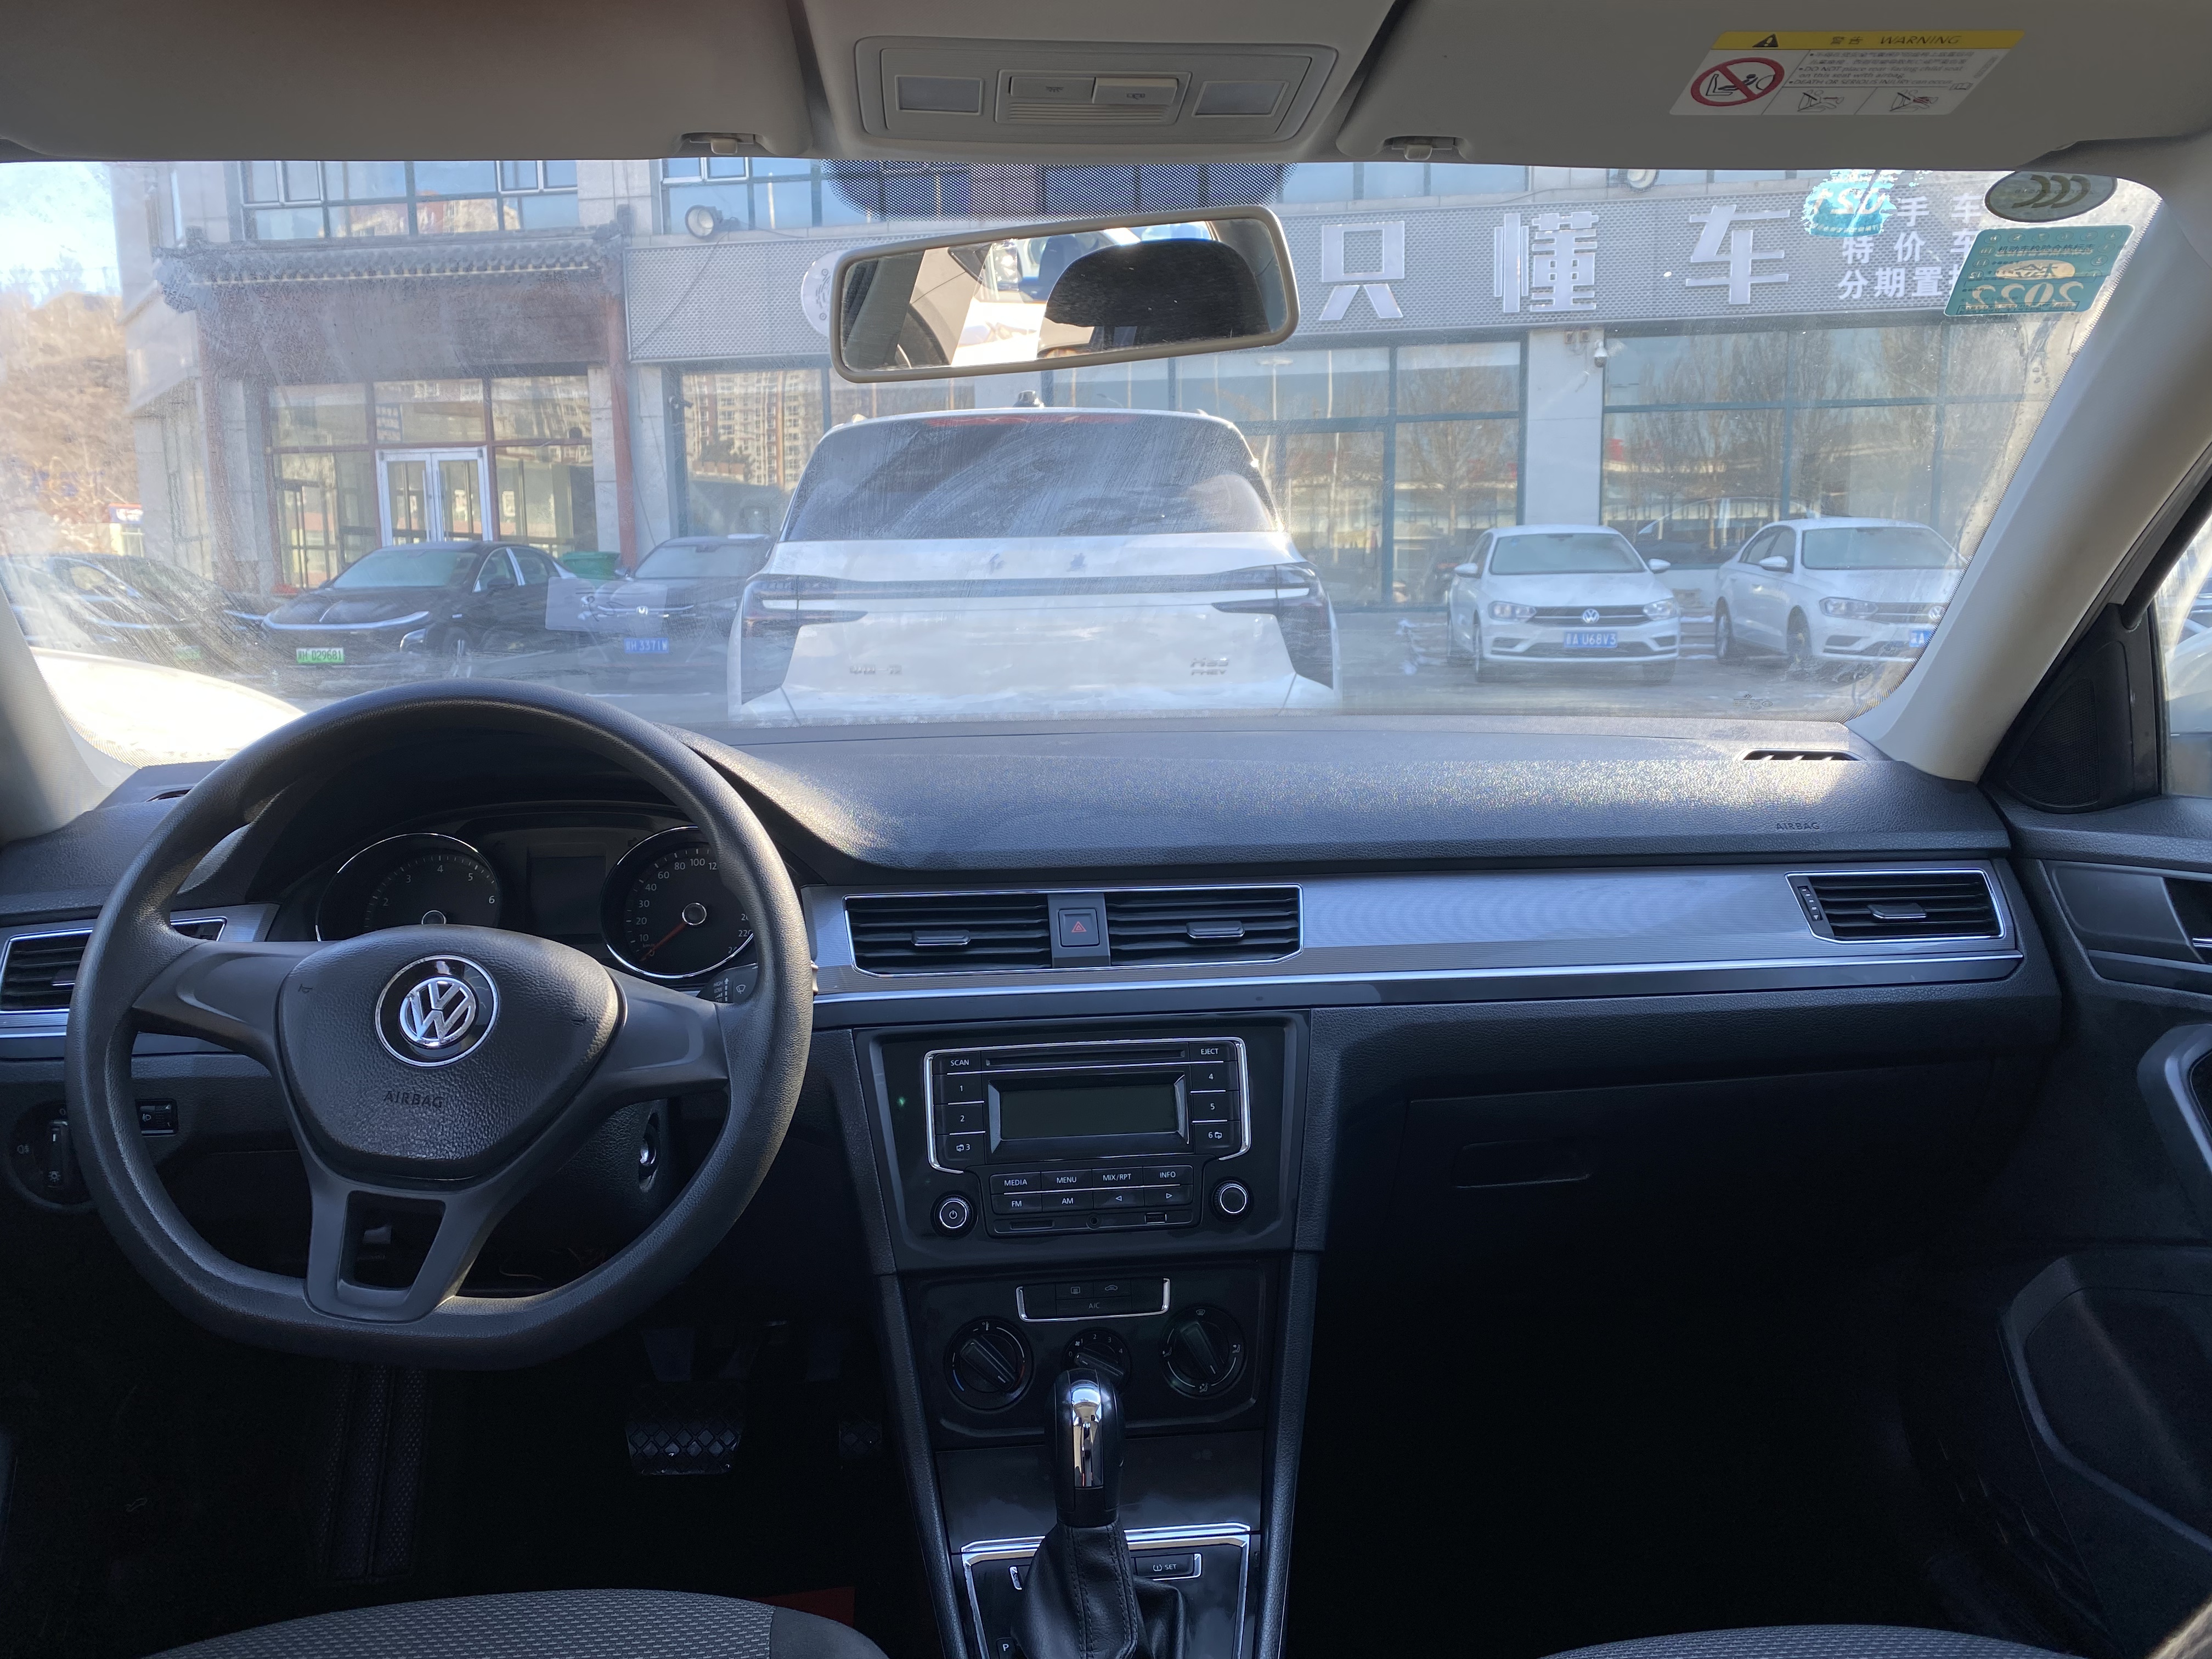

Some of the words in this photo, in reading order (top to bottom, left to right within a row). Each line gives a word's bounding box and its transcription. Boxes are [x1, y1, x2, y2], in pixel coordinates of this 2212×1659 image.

[1880, 35, 1962, 44] WARNING
[1319, 204, 1790, 320] 只懂车
[709, 862, 718, 870] 12
[639, 934, 649, 942] 10
[383, 1091, 445, 1108] AIRBAG
